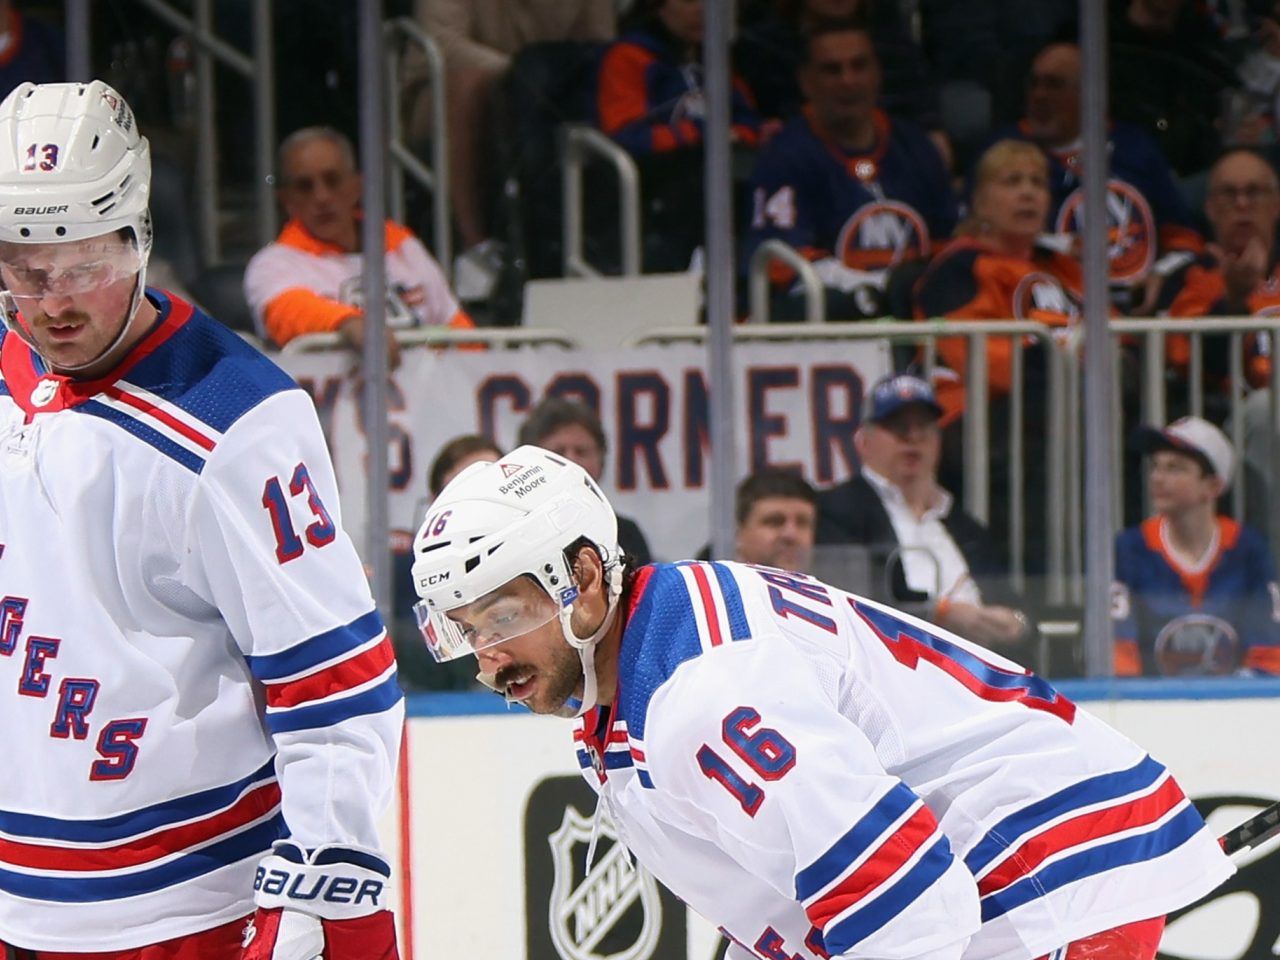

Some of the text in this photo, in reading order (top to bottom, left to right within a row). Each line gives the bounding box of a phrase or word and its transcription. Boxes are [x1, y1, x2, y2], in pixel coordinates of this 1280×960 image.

[24, 143, 59, 172] 13
[13, 204, 70, 216] BAUER
[498, 463, 544, 496] Benjamin
[514, 475, 548, 500] Moore
[261, 461, 336, 565] 13
[422, 509, 453, 540] 16
[420, 572, 451, 588] CCM
[695, 705, 797, 819] 16
[254, 864, 384, 907] BAUER
